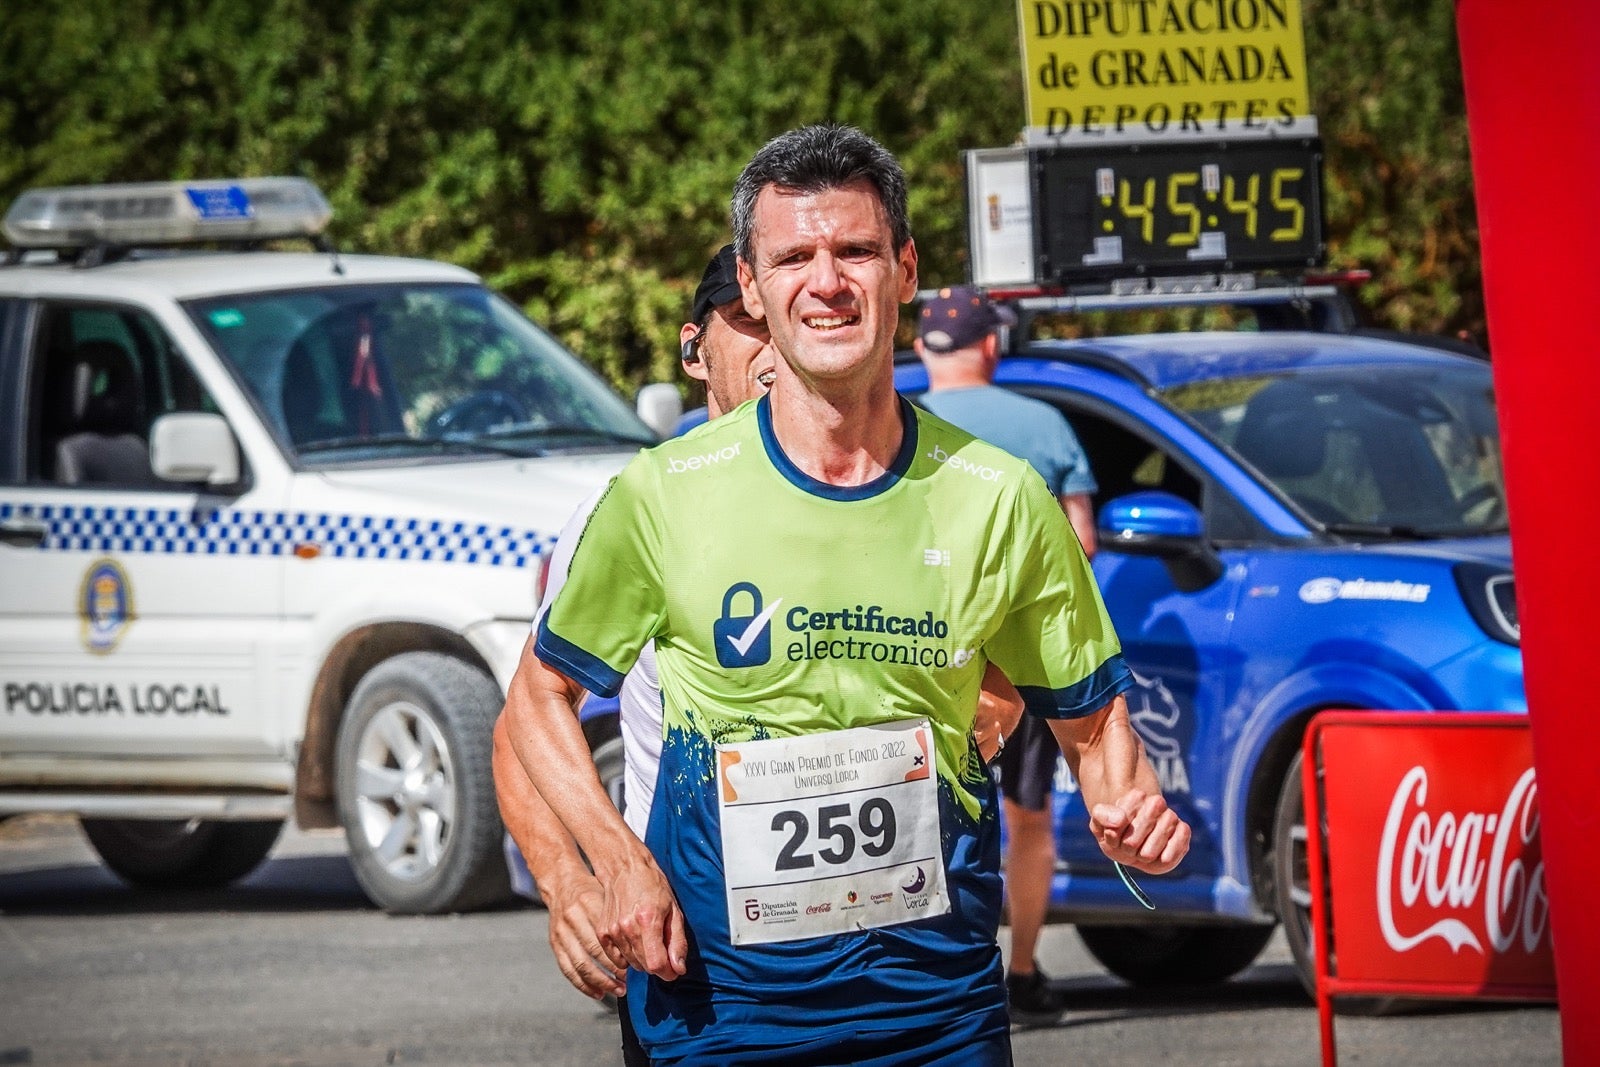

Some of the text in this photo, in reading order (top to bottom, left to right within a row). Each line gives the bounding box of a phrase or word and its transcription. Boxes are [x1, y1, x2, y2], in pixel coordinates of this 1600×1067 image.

[1039, 44, 1294, 89] de GRANADA
[1046, 97, 1297, 138] DEPORTES
[786, 604, 948, 639] Certificado
[4, 681, 231, 716] POLICIA LOCAL
[744, 762, 767, 778] XXXV
[882, 740, 907, 760] 2022
[770, 797, 897, 872] 259
[1376, 765, 1553, 954] Coca-Co
[761, 901, 798, 911] Diputación
[763, 908, 799, 918] de Granada
